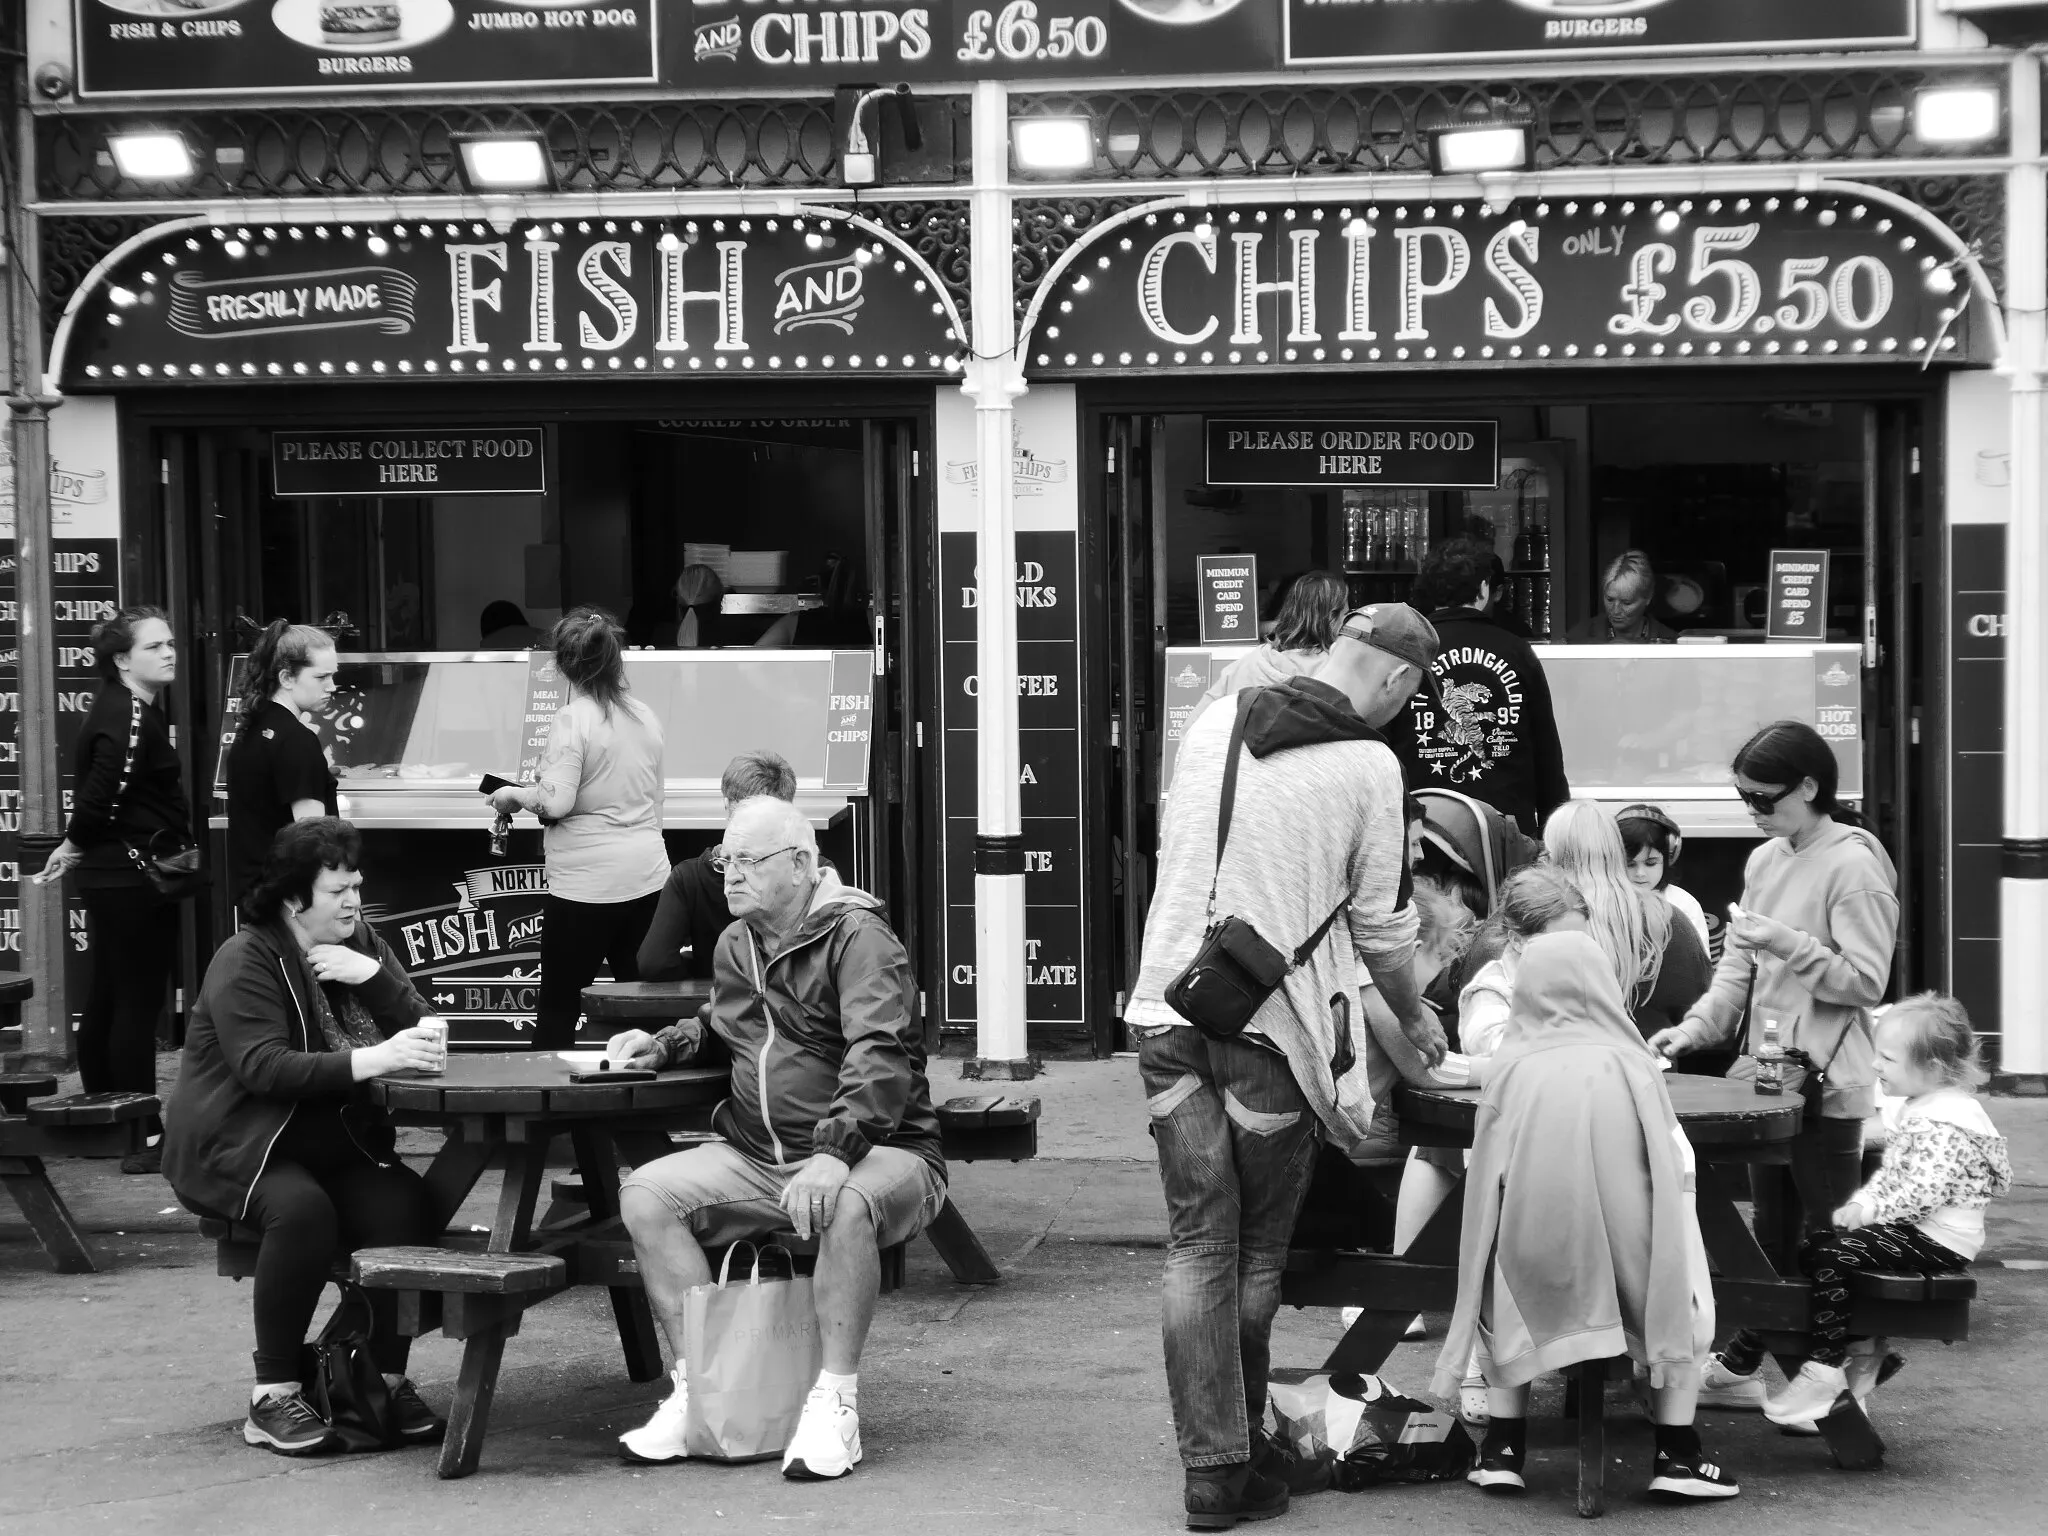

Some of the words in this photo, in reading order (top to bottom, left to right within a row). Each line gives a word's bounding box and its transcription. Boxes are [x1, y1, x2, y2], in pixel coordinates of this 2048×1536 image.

[467, 12, 540, 30] JUMBO
[544, 10, 587, 28] HOT
[592, 8, 637, 26] DOG
[109, 23, 157, 39] FISH
[160, 21, 177, 38] &
[181, 20, 243, 37] CHIPS
[694, 24, 741, 54] AND
[750, 9, 931, 64] CHIPS
[956, 0, 1107, 61] £6.50
[1544, 17, 1647, 38] BURGERS
[317, 56, 414, 74] BURGERS
[1136, 225, 1544, 345] CHIPS
[1563, 225, 1627, 257] ONLY
[1607, 222, 1894, 337] £5.50
[207, 286, 309, 322] FRESHLY
[314, 283, 381, 312] MADE
[444, 240, 750, 353] FISH
[773, 265, 864, 319] AND
[1228, 431, 1314, 450] PLEASE
[1320, 431, 1403, 450] ORDER
[1409, 431, 1475, 450] FOOD
[282, 441, 363, 461] PLEASE
[368, 440, 467, 460] COLLECT
[472, 439, 533, 458] FOOD
[1319, 455, 1383, 474] HERE
[379, 464, 439, 483] HERE
[1206, 568, 1250, 578] MINIMUM
[1776, 563, 1820, 573] MINIMUM
[1212, 579, 1245, 589] CREDIT
[1781, 575, 1814, 584] CREDIT
[1216, 591, 1241, 600] CARD
[1784, 587, 1810, 596] CARD
[54, 600, 118, 621] CHIPS
[1214, 603, 1244, 612] SPEND
[1781, 599, 1811, 608] SPEND
[1221, 614, 1239, 629] £5
[1785, 611, 1804, 625] £5
[1430, 647, 1523, 704] STRONGHOLD
[533, 690, 559, 699] MEAL
[532, 702, 558, 711] DEAL
[829, 695, 870, 710] FISH
[841, 714, 856, 726] AND
[1414, 712, 1435, 731] 18
[1497, 706, 1521, 725] 95
[1820, 710, 1853, 722] HOT
[828, 730, 868, 742] CHIPS
[1816, 723, 1857, 735] DOGS
[401, 909, 500, 966] FISH
